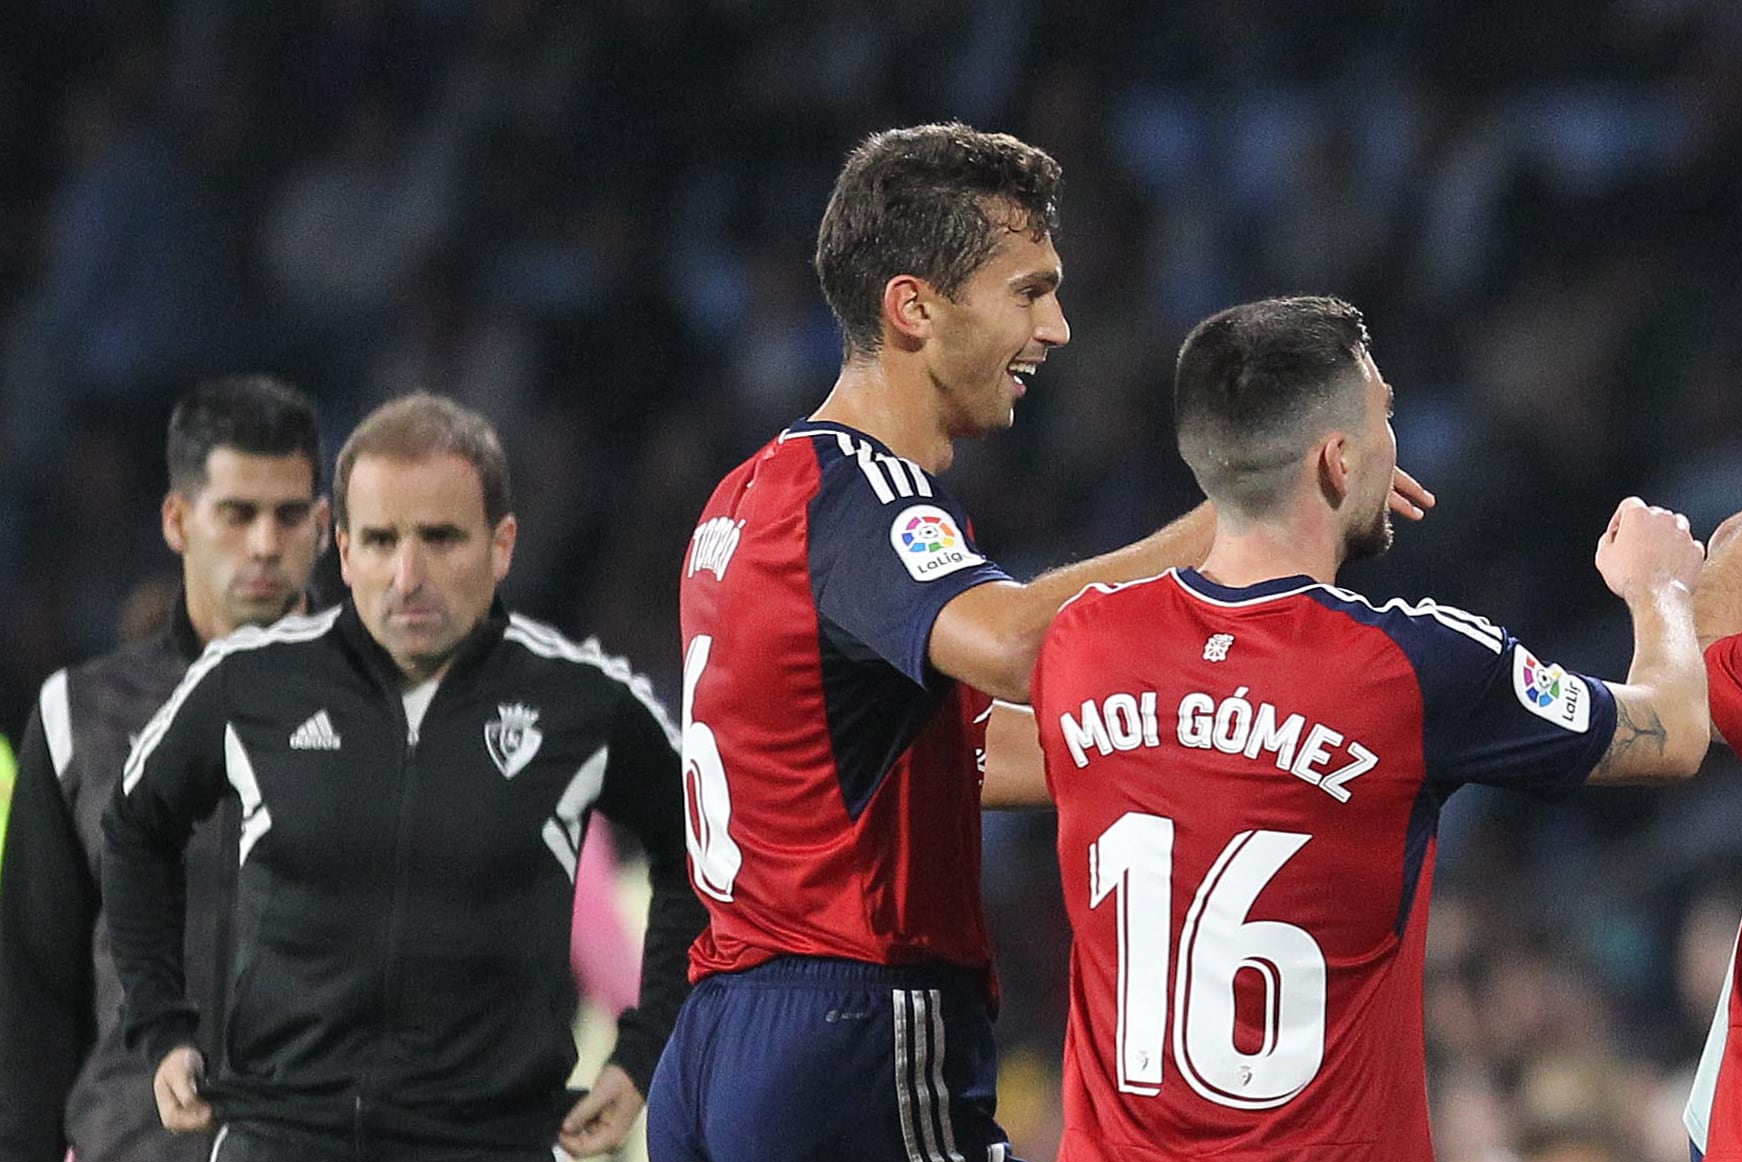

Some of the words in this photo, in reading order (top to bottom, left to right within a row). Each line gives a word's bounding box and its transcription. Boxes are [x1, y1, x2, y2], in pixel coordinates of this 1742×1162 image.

[917, 552, 965, 574] LaLig
[682, 634, 743, 903] 6
[1059, 692, 1158, 769] MOI
[1178, 685, 1379, 805] GÓMEZ
[1089, 811, 1328, 1110] 16
